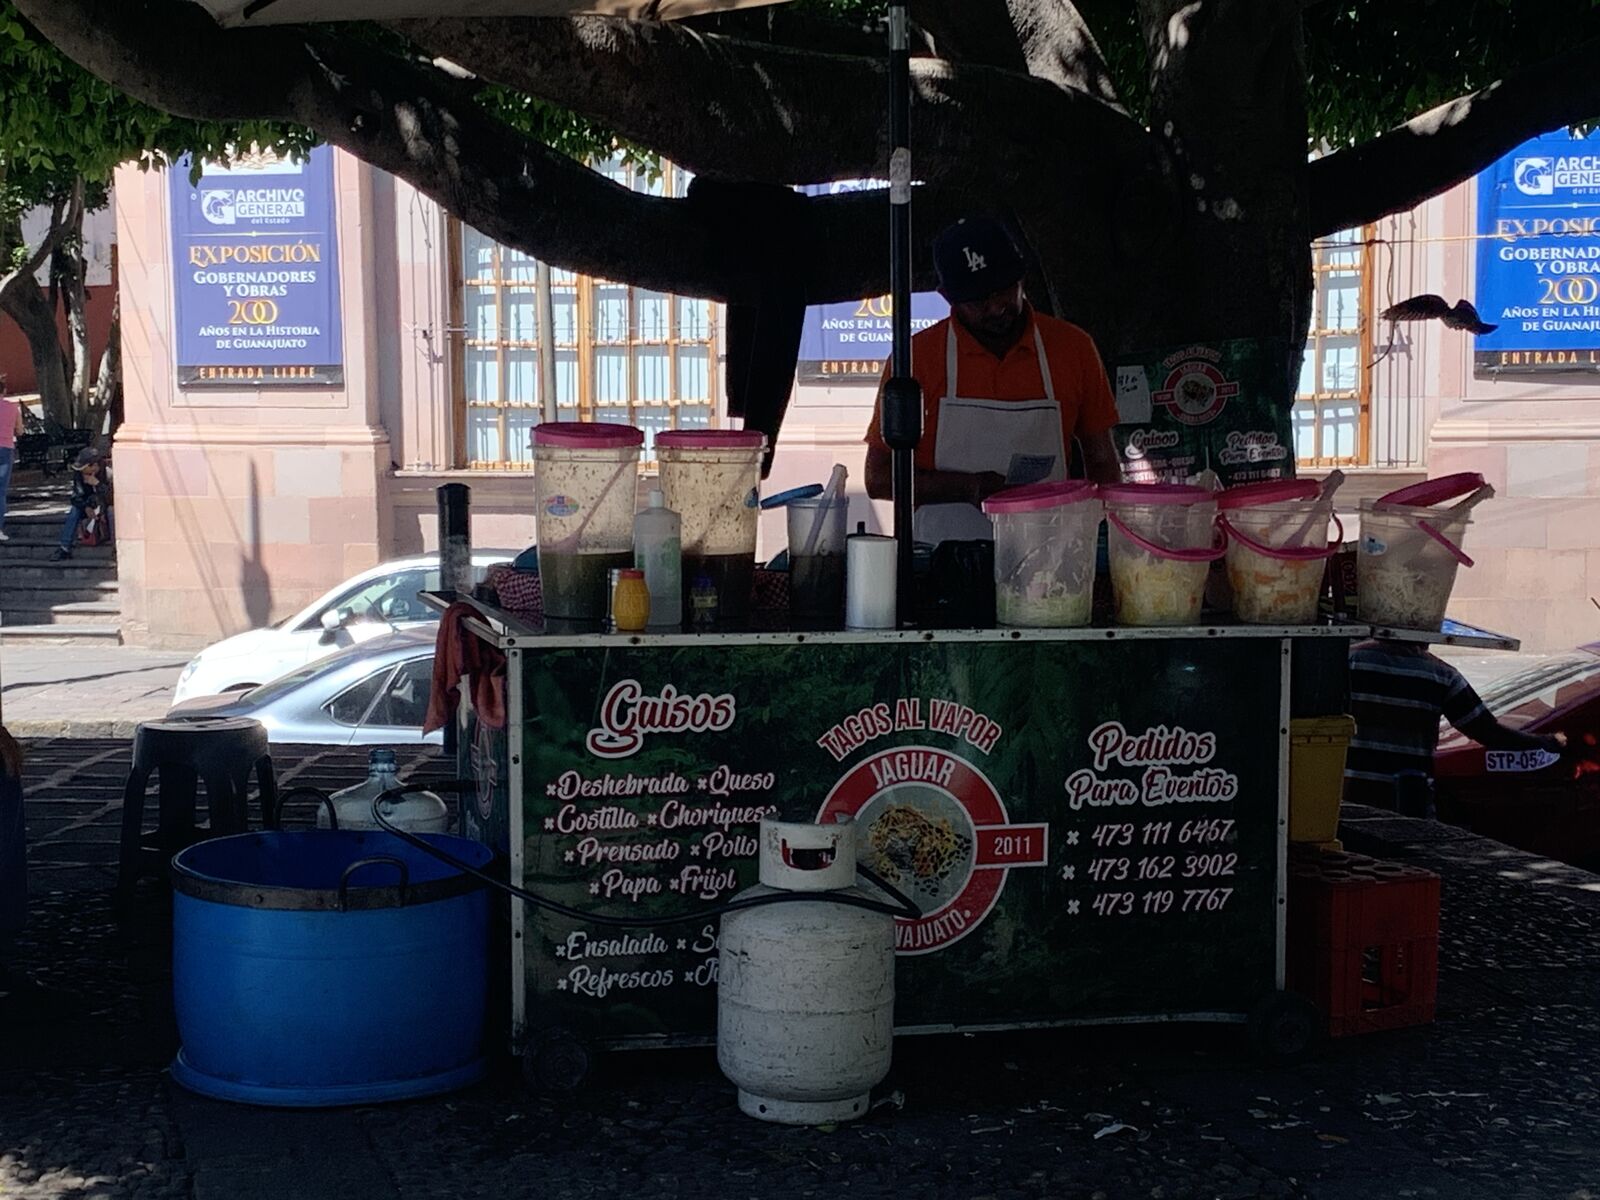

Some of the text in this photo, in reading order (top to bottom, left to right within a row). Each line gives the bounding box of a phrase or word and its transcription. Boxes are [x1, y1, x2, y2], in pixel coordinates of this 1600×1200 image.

[1555, 156, 1600, 171] ARCH
[1557, 172, 1600, 185] GENE
[236, 188, 305, 202] ARCHIVO
[1572, 187, 1586, 195] del
[238, 202, 303, 215] GENERAL
[189, 240, 321, 267] EXPOSICIÓN
[962, 246, 988, 272] LA
[1500, 246, 1600, 261] GOBERNAD
[1535, 260, 1600, 275] Y OBRA
[193, 270, 316, 285] GOBERNADORES
[224, 283, 288, 297] Y OBRAS
[1538, 277, 1598, 305] 200
[227, 299, 279, 325] 200
[1502, 305, 1538, 318] AÑOS
[1542, 307, 1559, 317] EN
[1563, 307, 1580, 317] LA
[199, 325, 320, 337] AÑOS EN LA HISTORIA
[822, 318, 855, 329] AÑOS
[857, 320, 873, 329] EN
[876, 320, 892, 329] LA
[1522, 321, 1539, 331] DE
[216, 338, 307, 350] DE GUANAJUATO
[840, 333, 855, 342] DE
[1502, 351, 1577, 364] ENTRADA
[200, 366, 316, 379] ENTRADA LIBRE
[822, 362, 879, 374] ENTRAD
[586, 679, 736, 758] Guisos
[817, 698, 1002, 762] TACOS AL VAPOR
[1088, 721, 1216, 772] Pedidos
[869, 752, 956, 789] JAGUAR
[557, 764, 775, 800] Deshebrada Queso
[1065, 766, 1238, 810] Para Eventos
[557, 804, 640, 833] Costilla
[1091, 823, 1134, 846] 473
[1142, 821, 1172, 845] 111
[577, 831, 758, 866] Prensado Pollo
[994, 836, 1031, 855] 2011
[1088, 852, 1238, 881] 473 162 3902
[602, 865, 737, 902] Papa Frijol
[1092, 887, 1234, 916] 473 119 7767
[566, 931, 668, 961] Ensalada
[569, 964, 674, 998] Refrescos
